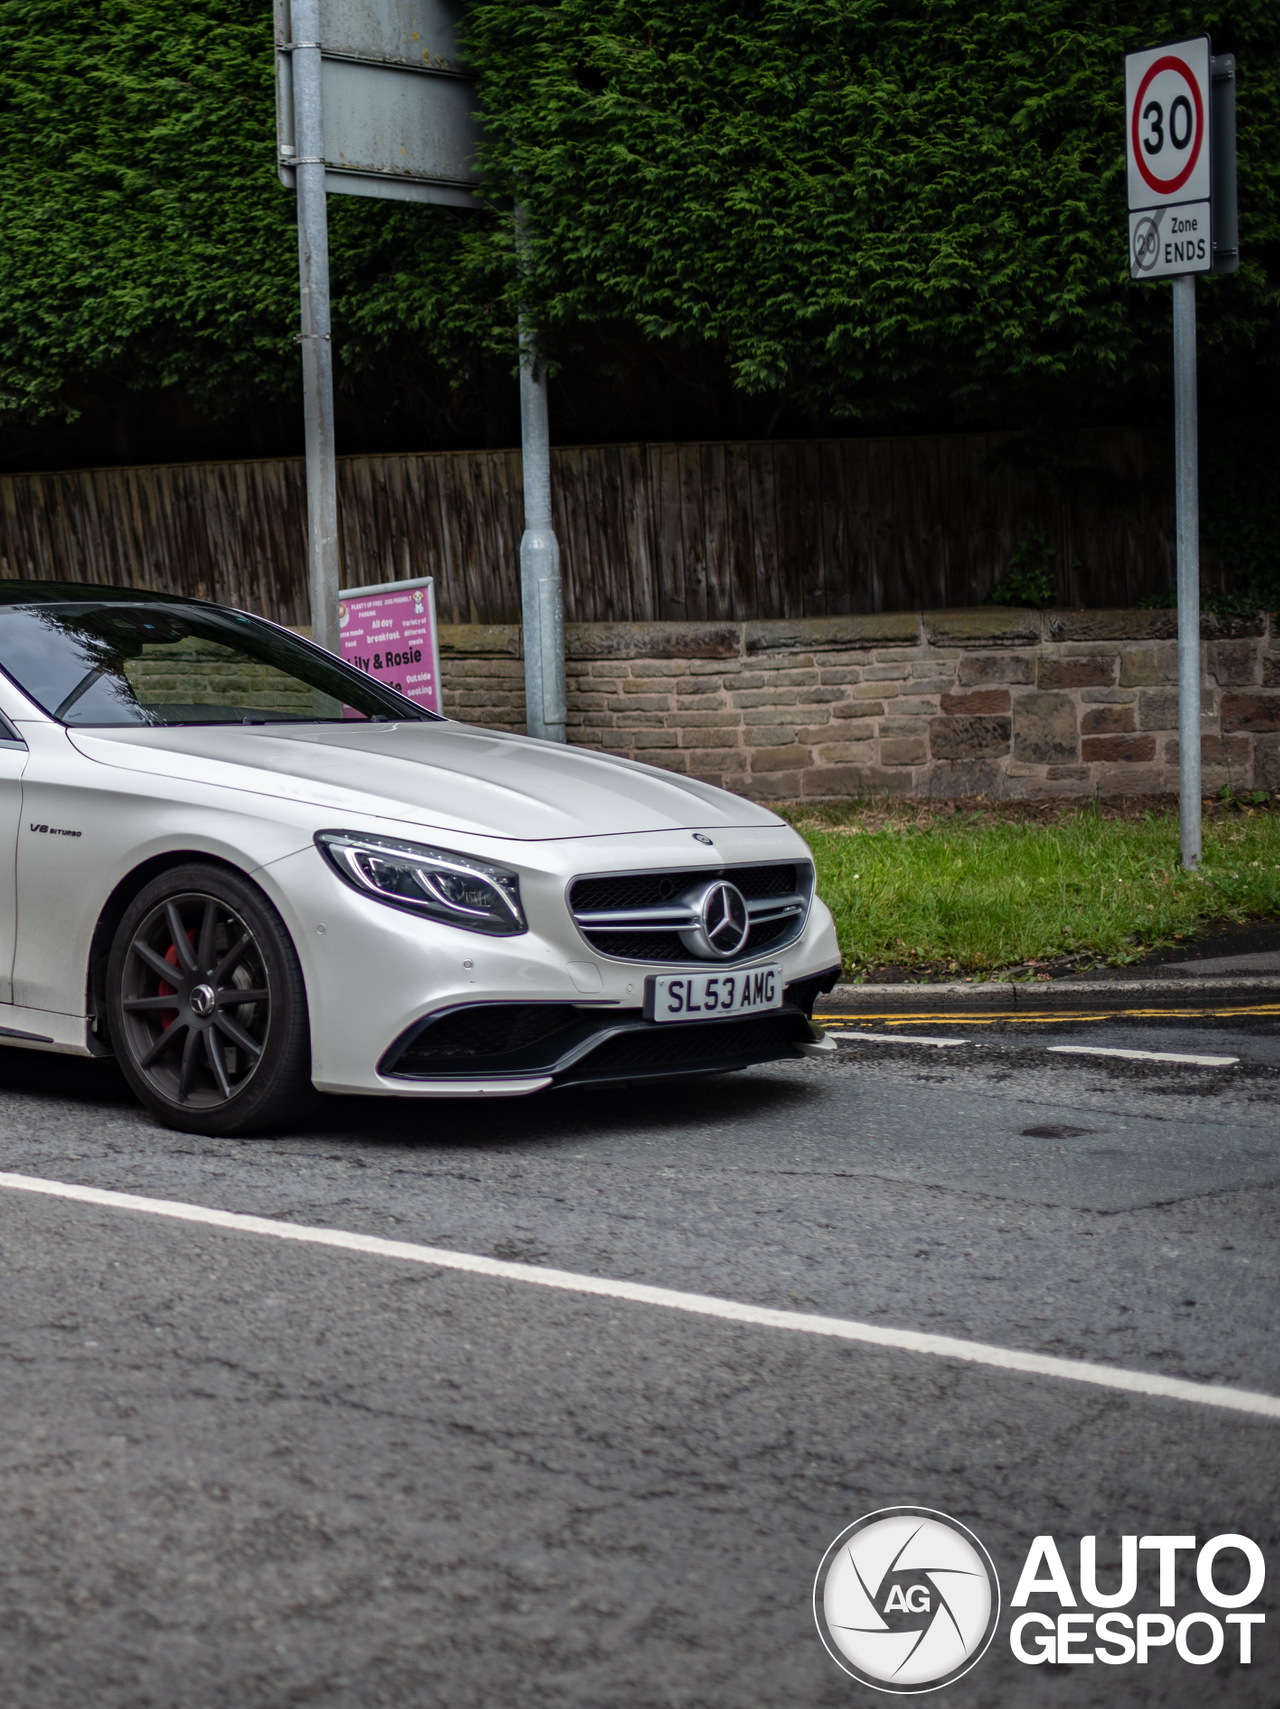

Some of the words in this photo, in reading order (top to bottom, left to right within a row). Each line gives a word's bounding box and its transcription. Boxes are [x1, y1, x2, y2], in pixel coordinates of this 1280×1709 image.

[1143, 95, 1193, 155] 30
[1171, 217, 1198, 234] Zone
[1136, 232, 1157, 256] 20
[1164, 239, 1206, 264] ENDS
[393, 596, 412, 605] FRIENDLY
[358, 610, 376, 618] PARKING
[372, 620, 380, 629] All
[381, 618, 393, 628] day
[402, 618, 420, 627] Variety
[366, 631, 400, 644] breakfast
[404, 627, 426, 637] different
[345, 640, 357, 648] food
[408, 638, 424, 646] meals
[347, 656, 370, 673] ily
[373, 653, 384, 670] &
[385, 646, 422, 668] Rosie
[406, 672, 431, 683] Outside
[407, 685, 433, 697] seating
[30, 823, 49, 833] V8
[49, 828, 82, 837] BITURBO
[667, 977, 736, 1013] SL53
[740, 970, 775, 1007] AMG
